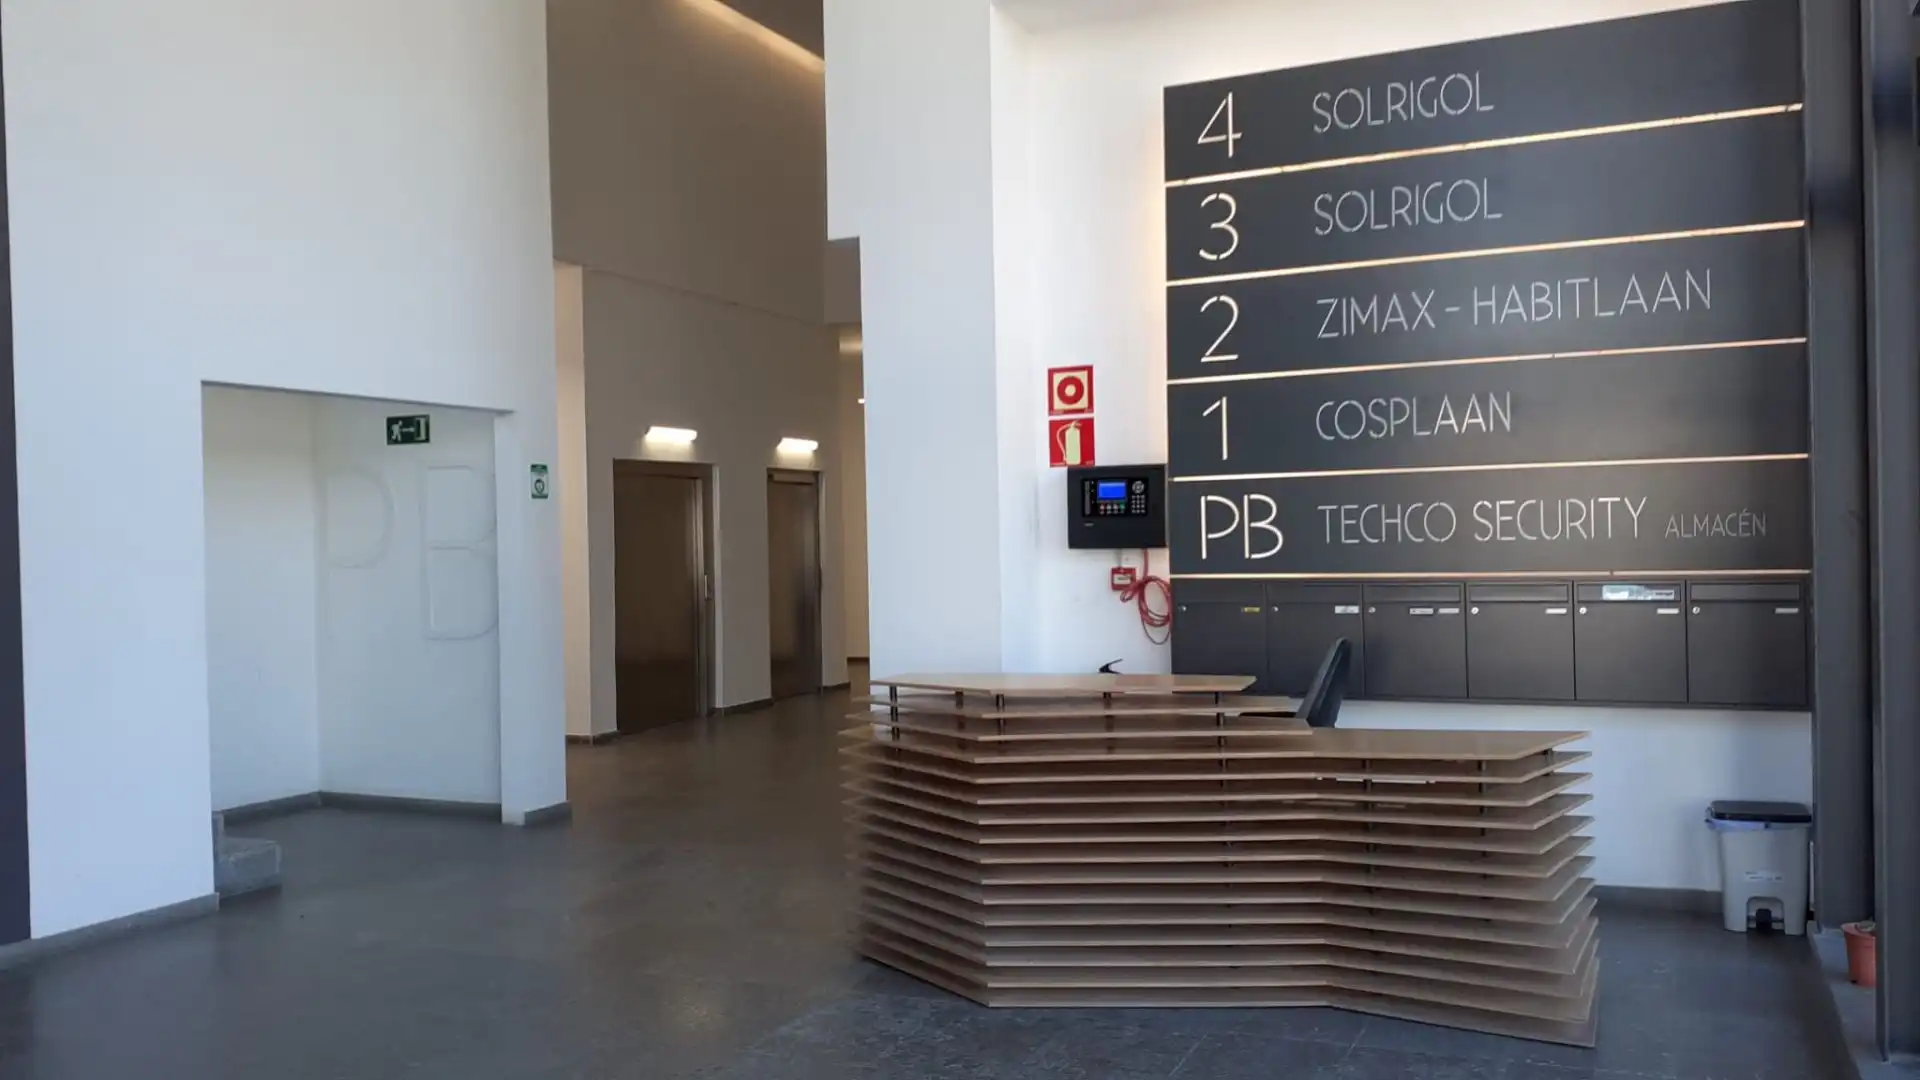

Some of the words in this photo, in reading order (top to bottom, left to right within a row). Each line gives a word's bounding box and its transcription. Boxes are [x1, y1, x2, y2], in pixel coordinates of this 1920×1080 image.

[1198, 92, 1242, 158] 4
[1312, 70, 1494, 133] SOLRIGOL
[1199, 192, 1239, 261] 3
[1314, 178, 1502, 235] SOLRIGOL
[1200, 294, 1239, 362] 2
[1317, 290, 1435, 339] ZIMAX
[1474, 269, 1711, 325] HABITLAAN
[1202, 396, 1229, 461] 1
[1316, 392, 1511, 441] COSPLAAN
[1201, 494, 1284, 560] PB
[1318, 502, 1456, 543] TECHCO
[1473, 497, 1646, 542] SECURITY
[1665, 509, 1766, 538] ALMACÉN
